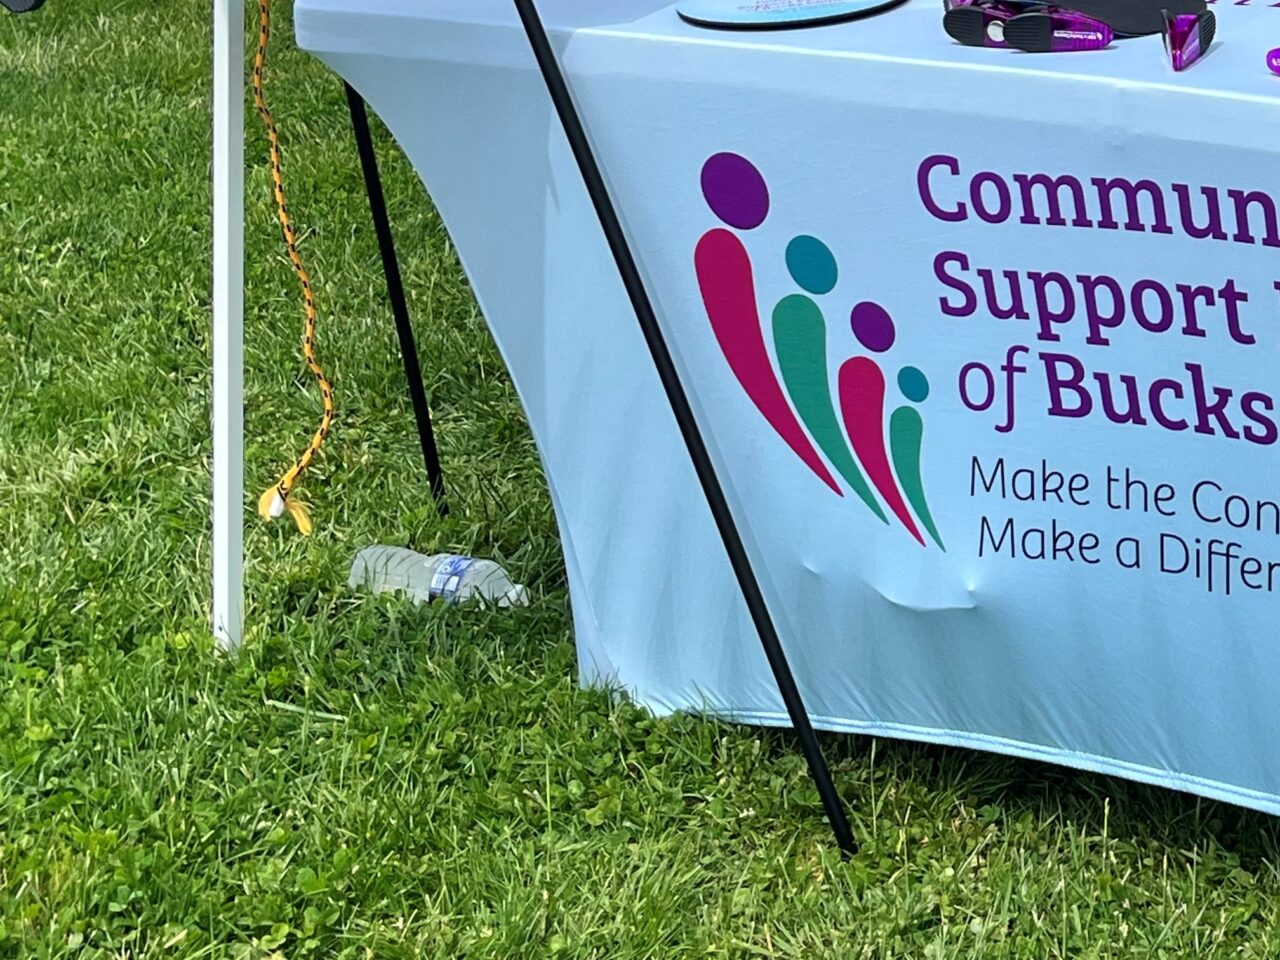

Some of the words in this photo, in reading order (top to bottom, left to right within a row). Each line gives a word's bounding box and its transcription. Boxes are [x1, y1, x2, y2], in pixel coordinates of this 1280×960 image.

[932, 249, 1257, 346] Support
[958, 344, 1031, 434] of
[1038, 351, 1279, 446] Bucks
[969, 455, 1091, 507] Make
[1105, 465, 1177, 518] the
[977, 514, 1101, 566] Make
[1114, 539, 1141, 571] a
